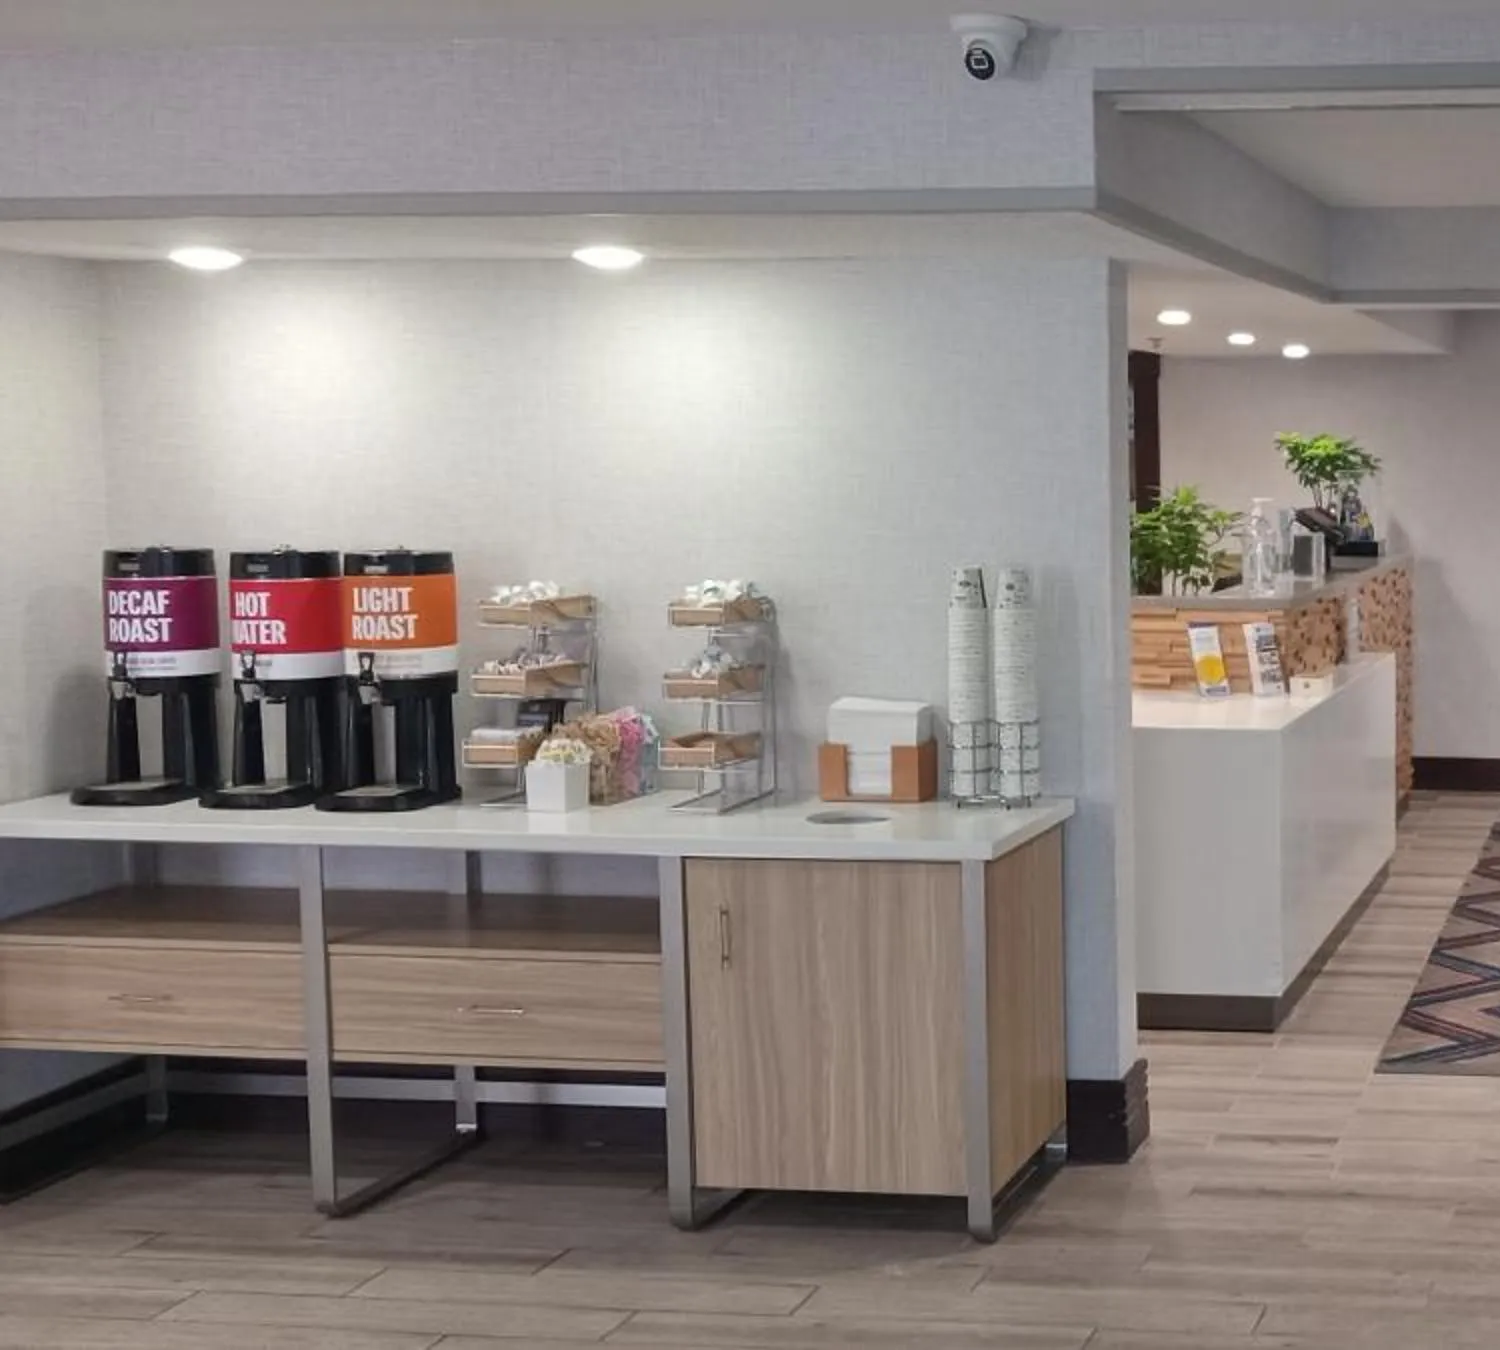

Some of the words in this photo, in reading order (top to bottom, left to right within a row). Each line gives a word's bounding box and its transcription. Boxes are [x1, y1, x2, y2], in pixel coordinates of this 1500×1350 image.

[108, 588, 171, 615] DECAF
[234, 591, 272, 617] HOT
[352, 586, 415, 613] LIGHT
[108, 617, 174, 643] ROAST
[351, 613, 419, 641] ROAST
